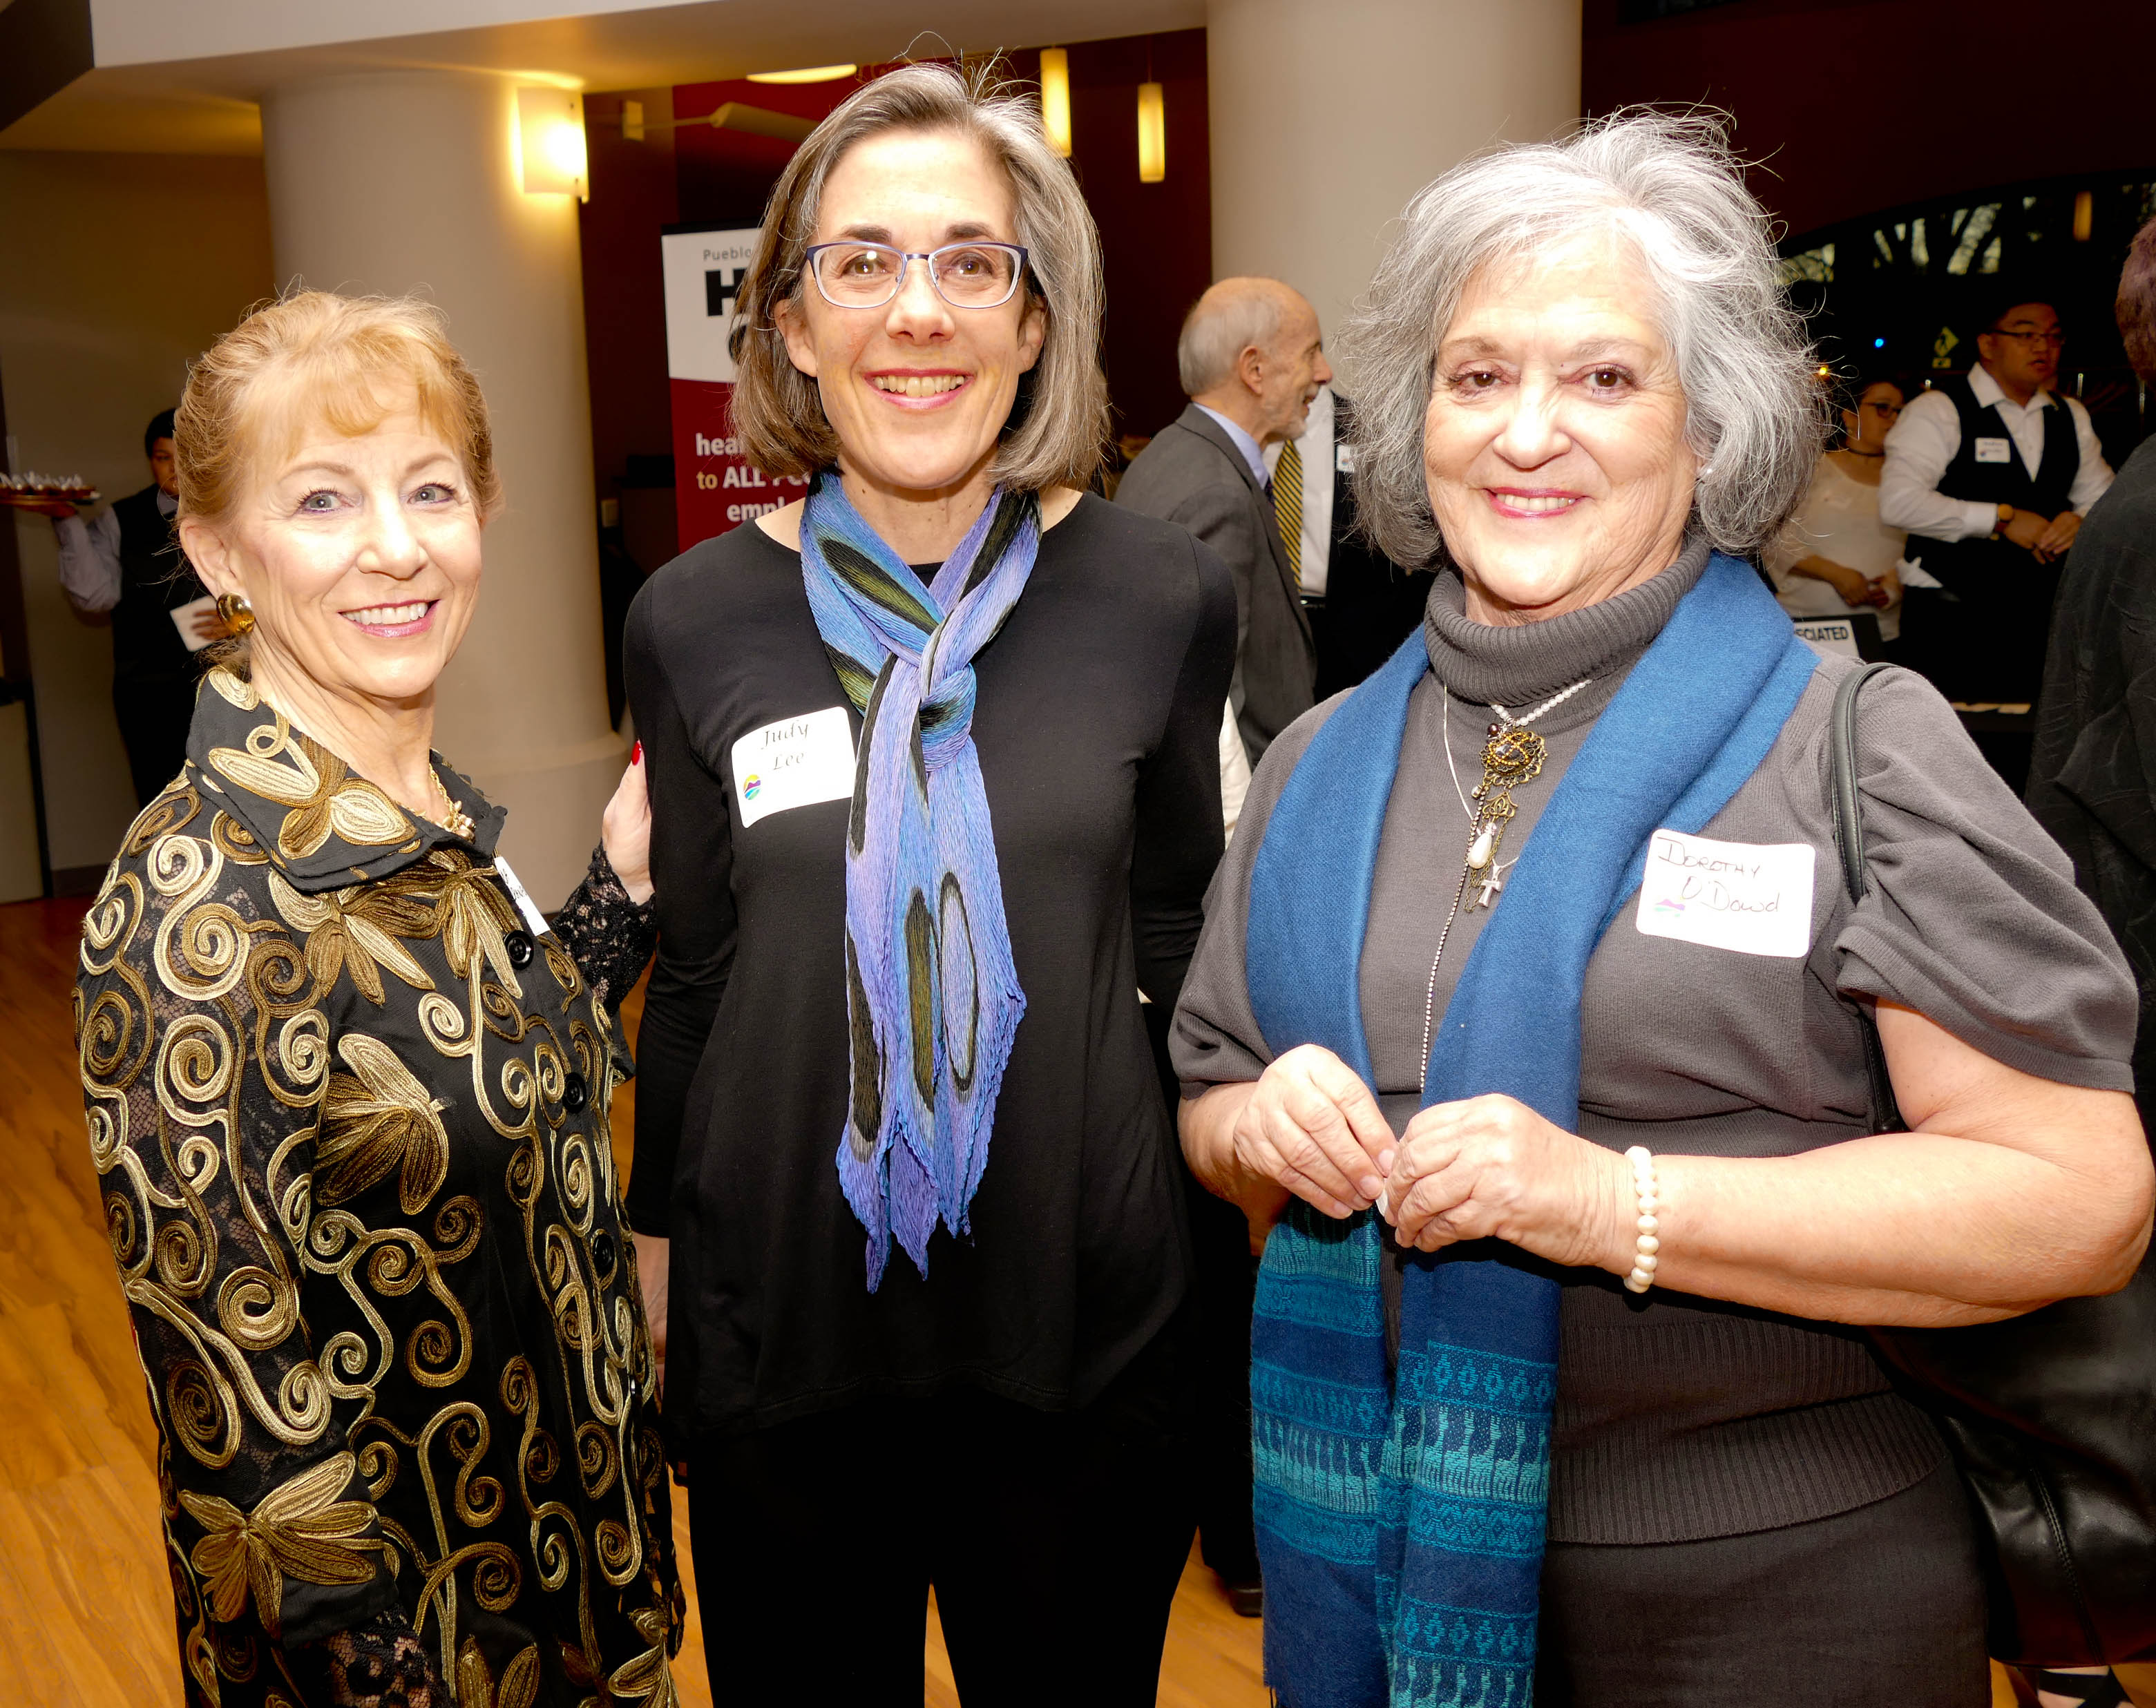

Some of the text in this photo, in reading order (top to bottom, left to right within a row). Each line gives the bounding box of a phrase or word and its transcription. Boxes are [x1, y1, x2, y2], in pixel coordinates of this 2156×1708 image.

[696, 471, 718, 490] to
[723, 466, 767, 488] ALL
[761, 720, 809, 749] Judy
[772, 752, 805, 771] Lee
